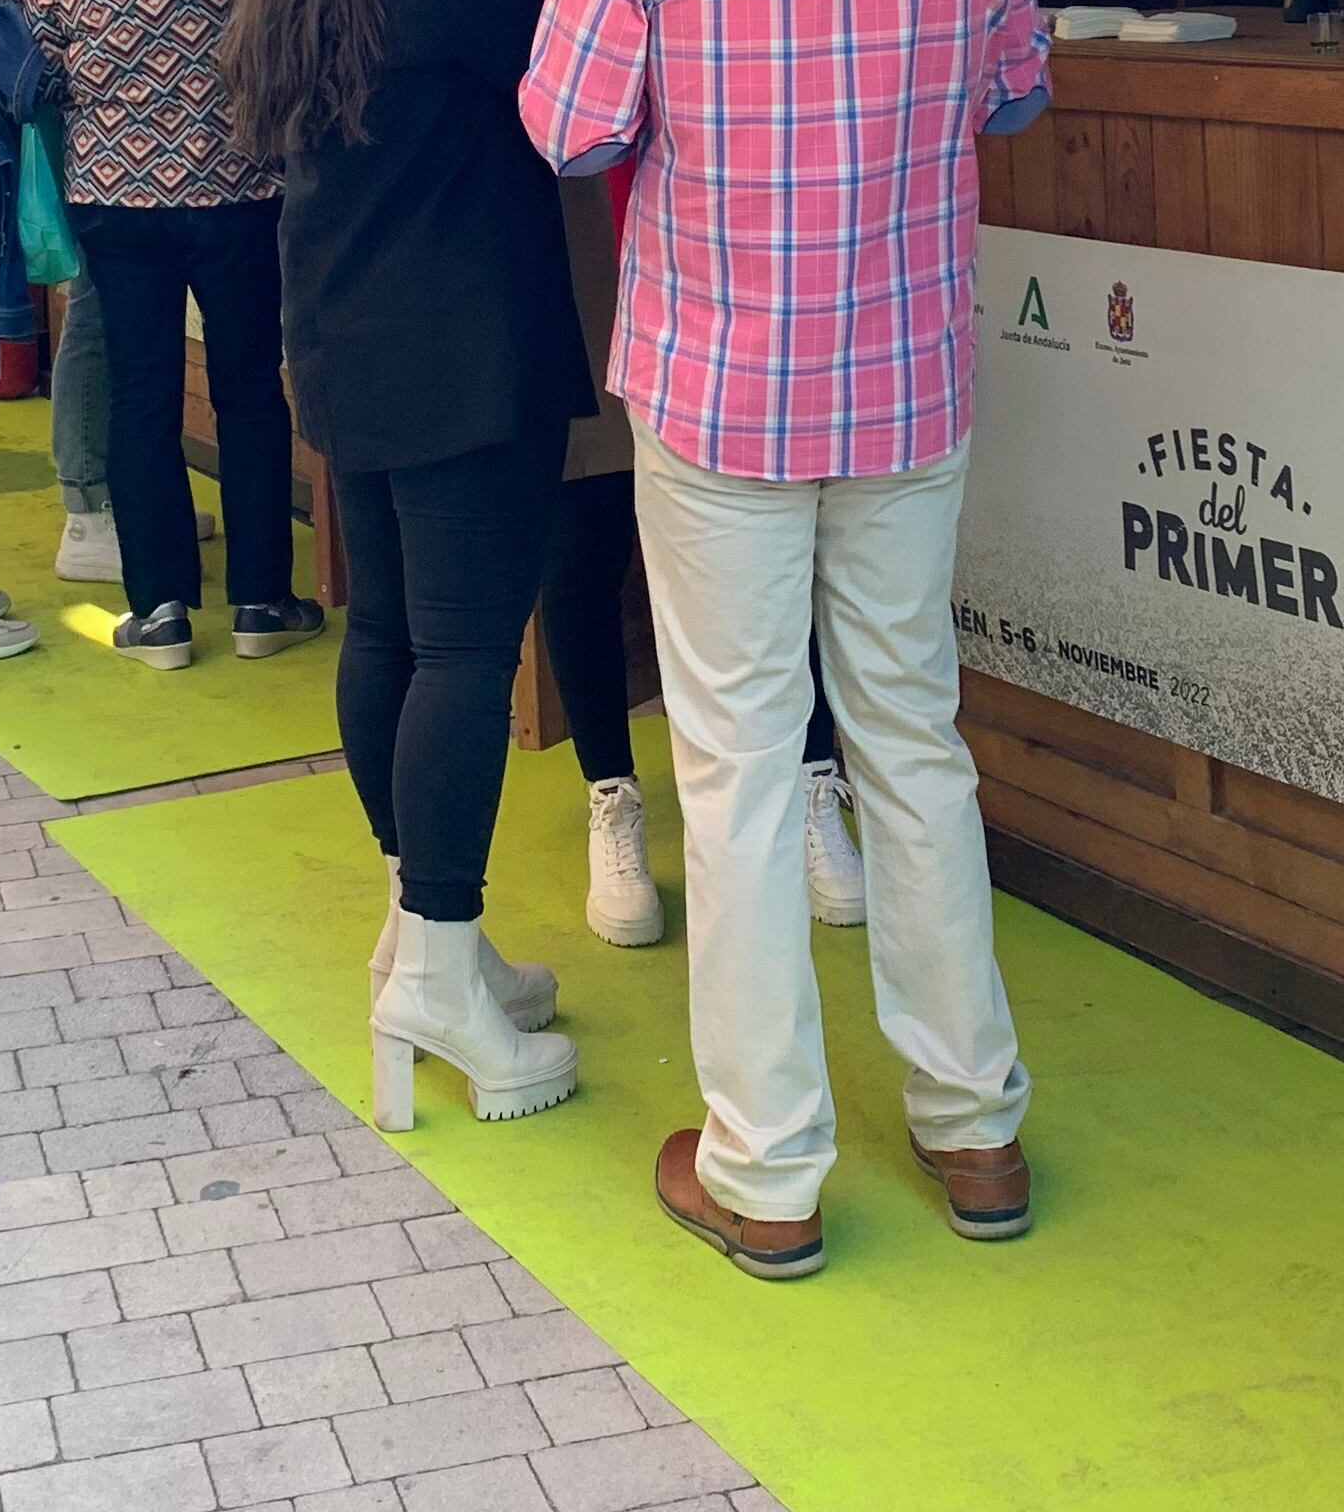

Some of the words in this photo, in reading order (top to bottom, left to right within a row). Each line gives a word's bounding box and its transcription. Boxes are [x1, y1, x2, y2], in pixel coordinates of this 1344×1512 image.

[1000, 328, 1021, 343] Junta
[1022, 333, 1033, 345] de
[1032, 334, 1071, 352] Andalucía
[1199, 481, 1248, 536] del
[1121, 500, 1344, 630] PRIMER
[999, 618, 1037, 653] 5-6
[1058, 639, 1160, 691] NOVIEMBRE
[1169, 676, 1212, 707] 2022
